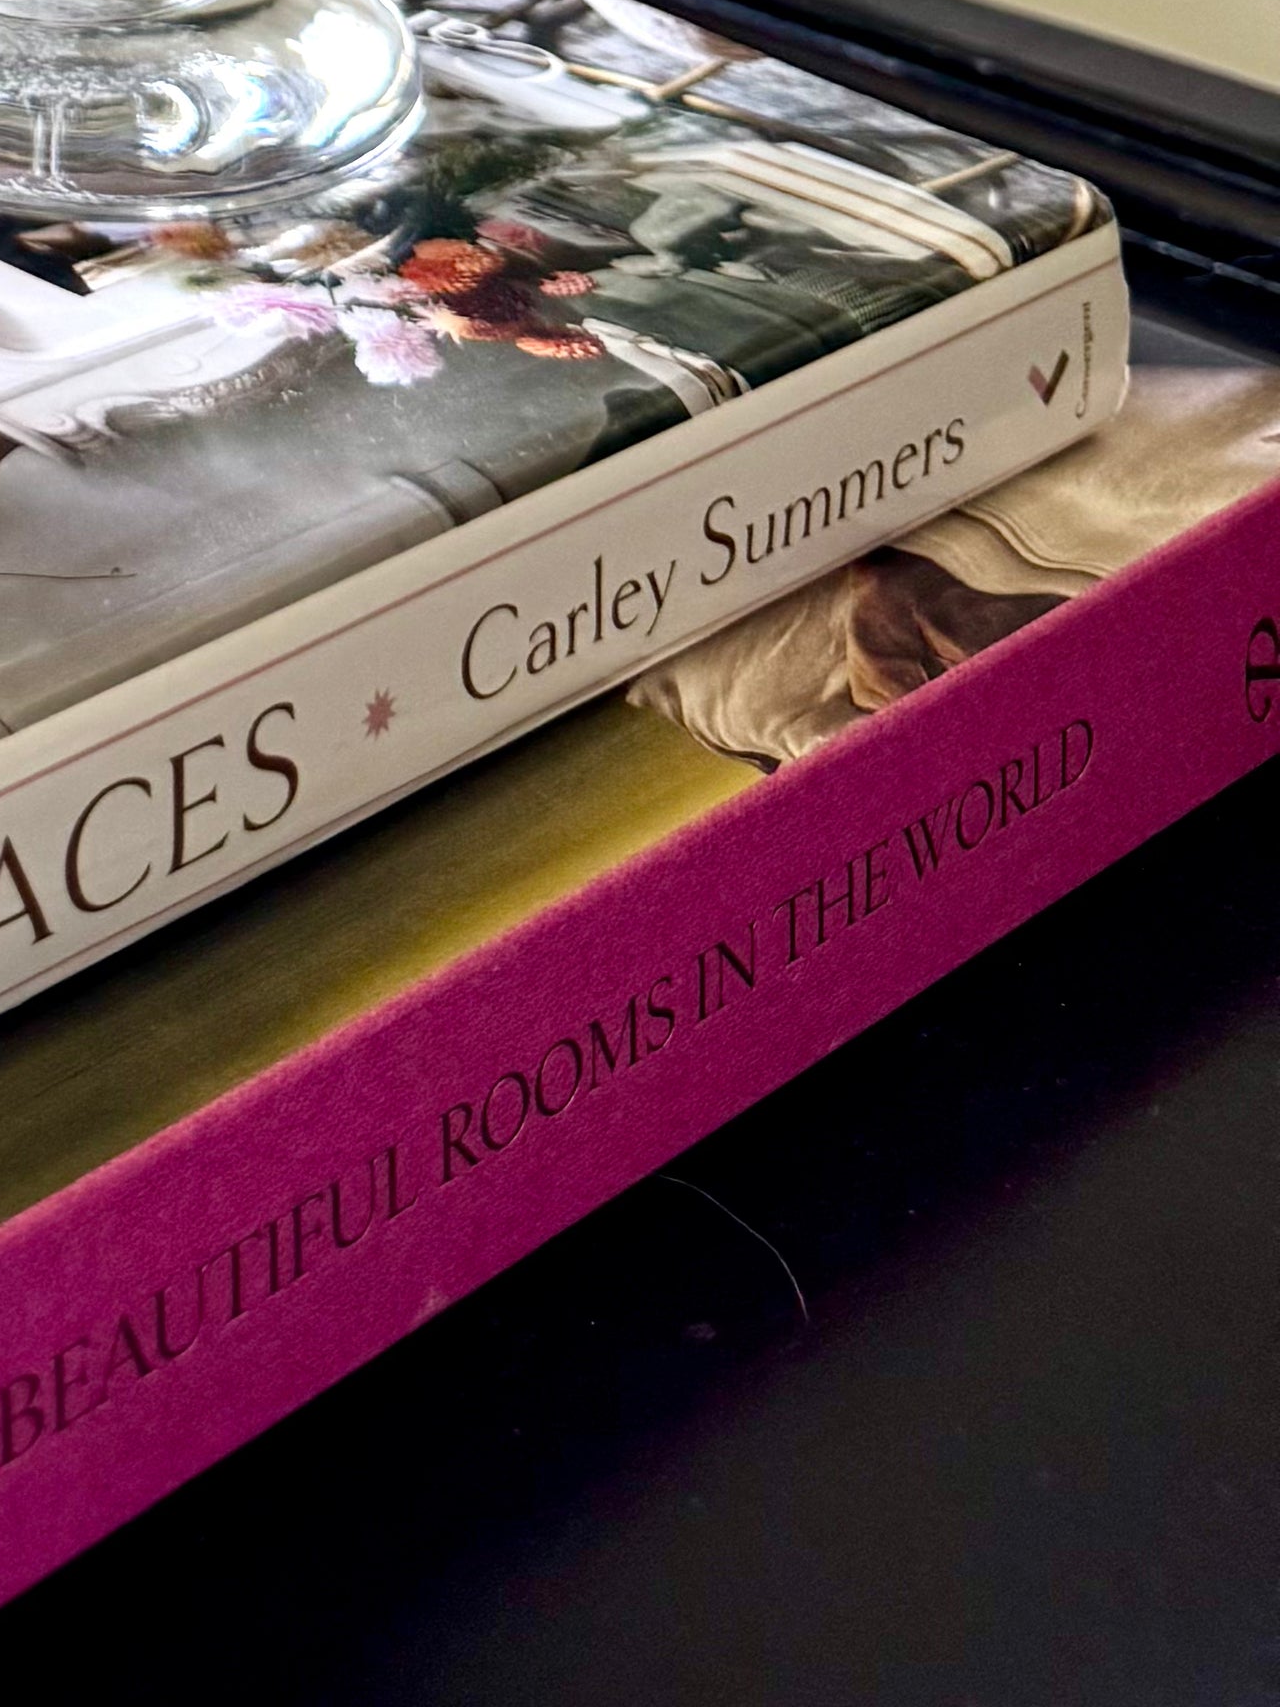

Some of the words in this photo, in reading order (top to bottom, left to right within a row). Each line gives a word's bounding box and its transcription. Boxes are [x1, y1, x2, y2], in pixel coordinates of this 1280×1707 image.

[460, 555, 676, 702] Carley
[699, 415, 966, 589] Summers
[439, 974, 677, 1187] ROOMS
[694, 920, 761, 1029] IN
[771, 838, 895, 968] THE
[900, 718, 1096, 882] WORLD
